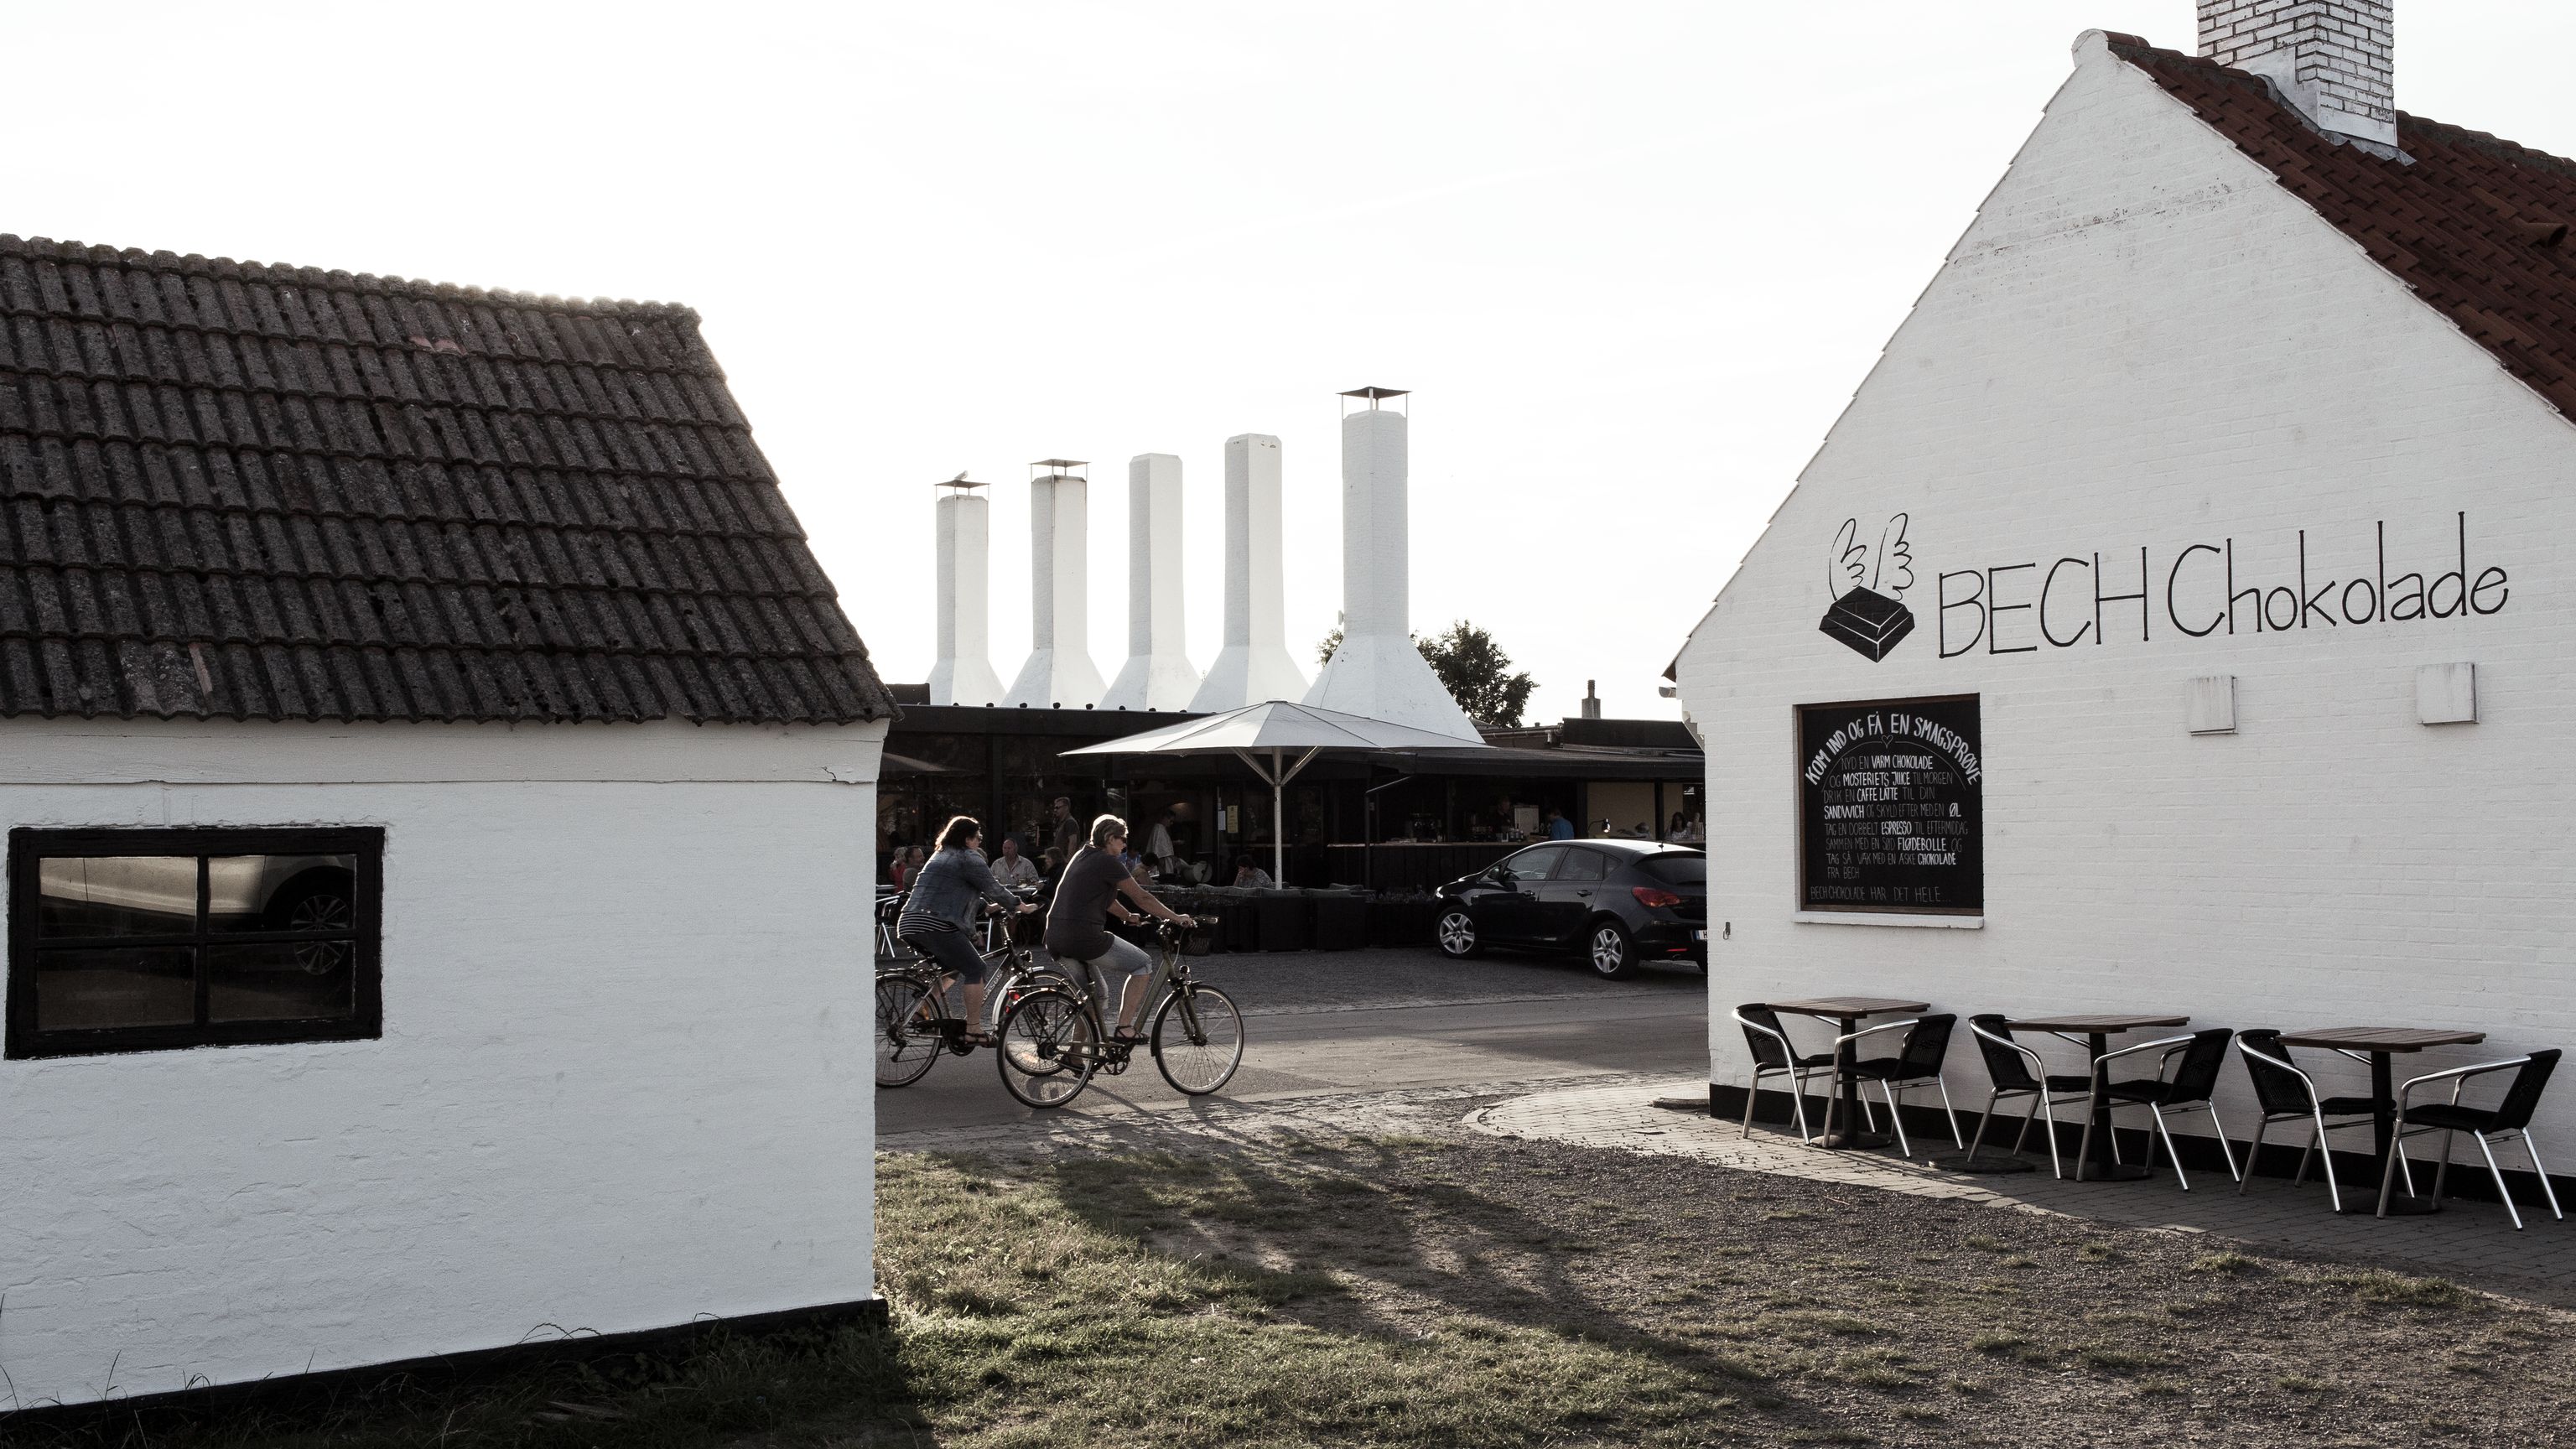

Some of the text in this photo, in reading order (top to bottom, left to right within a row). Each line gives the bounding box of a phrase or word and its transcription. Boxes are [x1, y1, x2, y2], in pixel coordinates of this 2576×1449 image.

[1938, 511, 2510, 660] BECH Chokolade
[1805, 711, 1982, 785] KOM IND OG FÅ EN SMAGSPRØVE
[1841, 755, 1933, 771] NYD EN VARM CHOKOLADE
[1830, 771, 1953, 787] OG MOSTERIETS JUICE TIL MORGEN
[1824, 787, 1935, 803] DRIK EN CAFFE LATTE TIL DIN
[1824, 802, 1961, 819] SANDWICH OG SKYLD EFTER MED EN ØL
[1825, 821, 1968, 836] TAG EN DOBBELT ESPRESSO TIL EFTERMIDDAG
[1826, 839, 1853, 850] SAMMEN
[1855, 838, 1869, 850] MED
[1872, 838, 1880, 850] EN
[1898, 837, 1947, 852] FLØDEBOLLE
[1951, 839, 1962, 852] OG
[1826, 854, 1839, 865] TAG
[1872, 853, 1885, 864] MED
[1888, 854, 1895, 865] EN
[1918, 853, 1956, 865] CHOKOLADE
[1827, 867, 1860, 880] FRA BECH
[1871, 886, 1886, 901] HAR
[1893, 887, 1908, 902] DET
